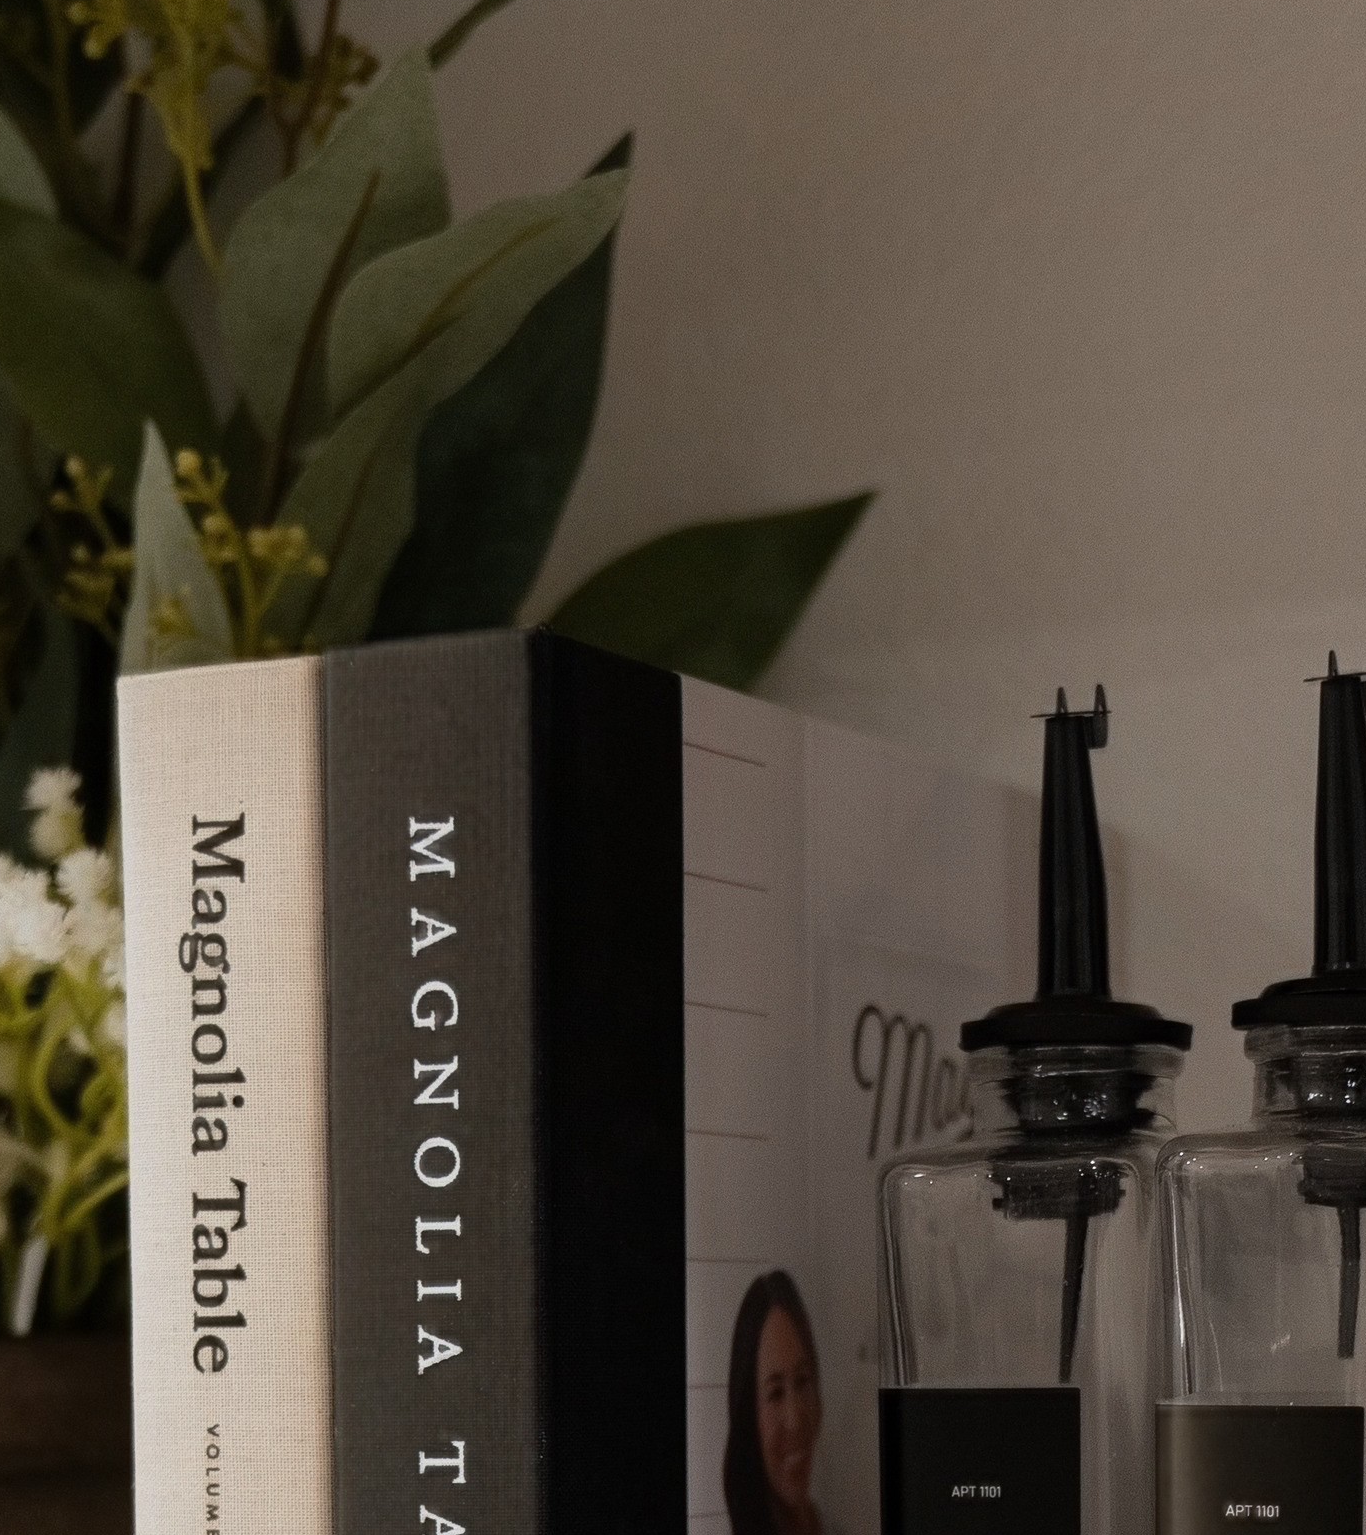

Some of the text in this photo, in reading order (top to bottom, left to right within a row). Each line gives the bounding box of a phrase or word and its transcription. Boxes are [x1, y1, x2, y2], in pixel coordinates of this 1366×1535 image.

[178, 812, 247, 1373] Magnolia Table
[408, 816, 463, 1374] MAGNOLIA
[951, 1484, 1002, 1499] APT 1101
[1225, 1503, 1280, 1519] APT 1101
